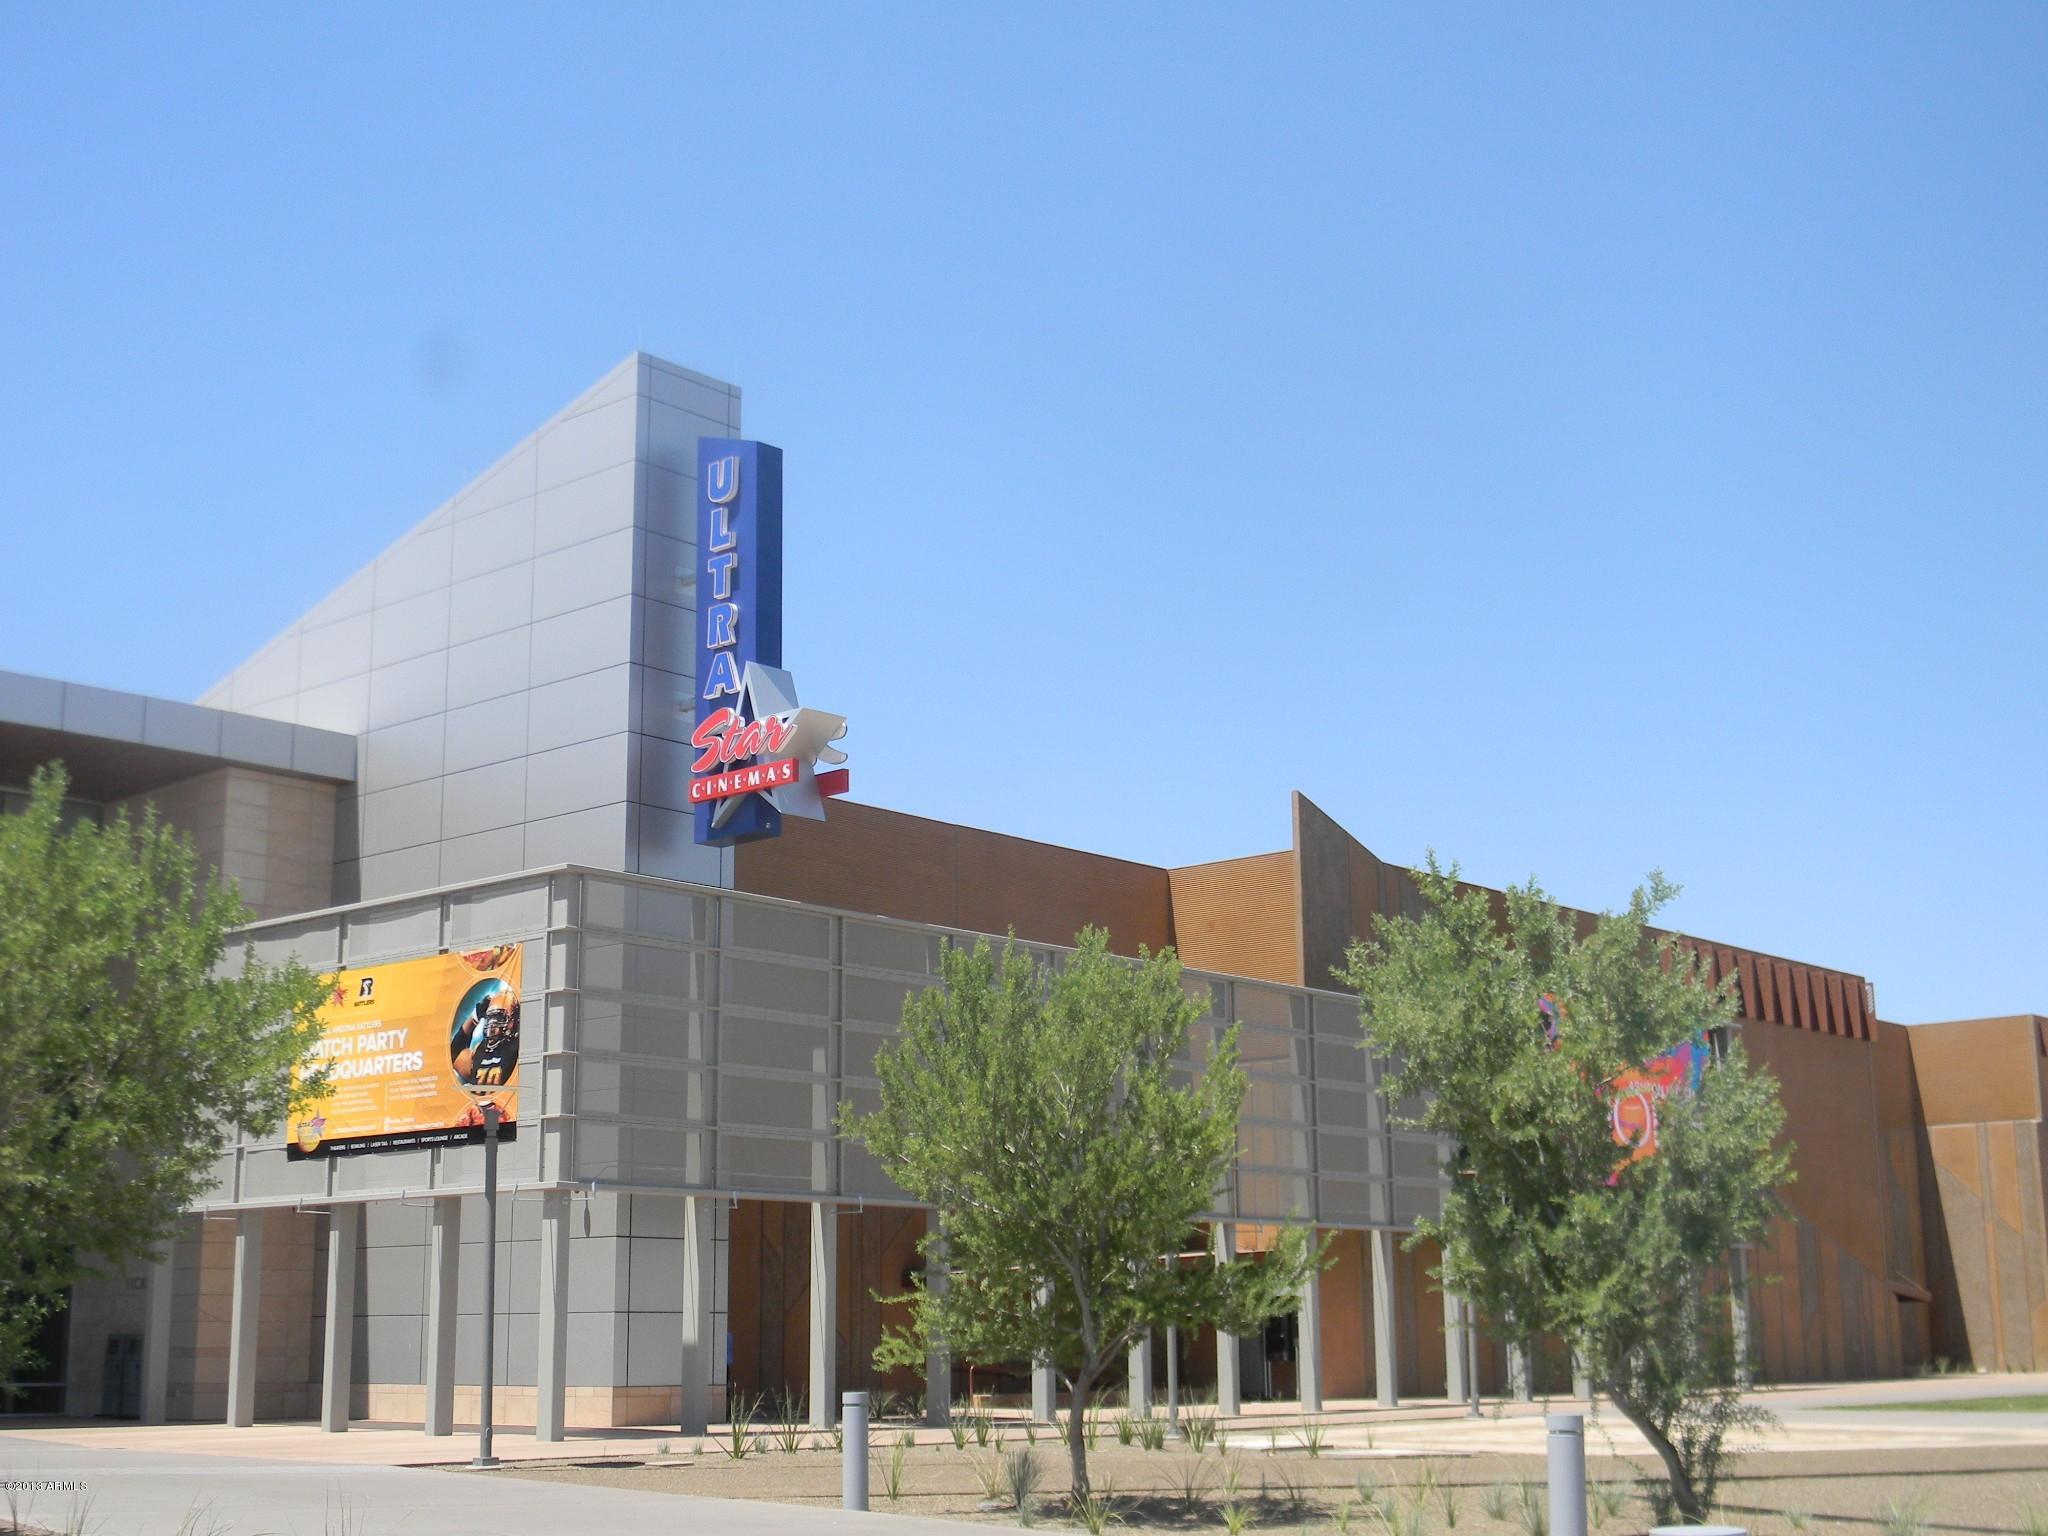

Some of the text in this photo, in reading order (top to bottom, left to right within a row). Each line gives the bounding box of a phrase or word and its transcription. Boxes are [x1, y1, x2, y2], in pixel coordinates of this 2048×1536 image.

[702, 455, 741, 700] ULTRA
[691, 707, 798, 773] Star
[357, 1028, 408, 1055] PARTY
